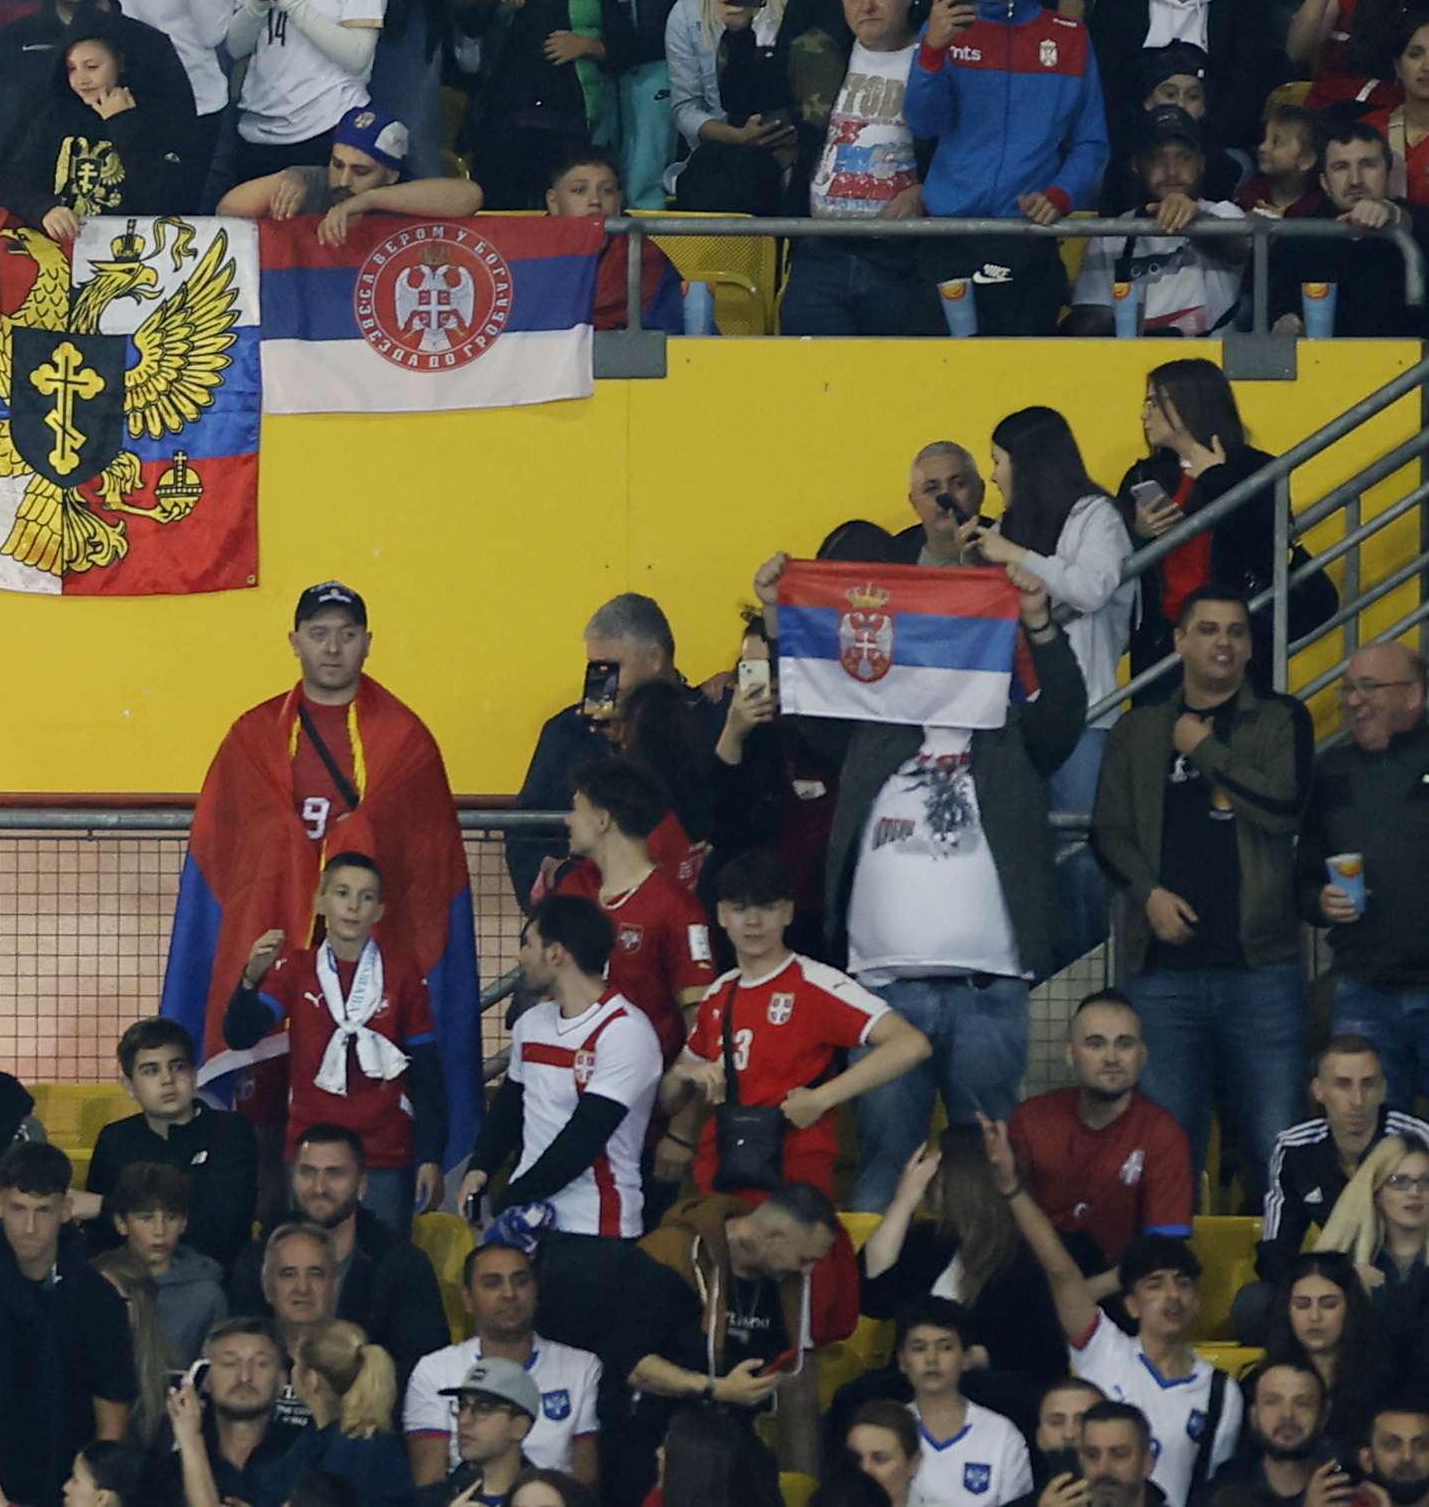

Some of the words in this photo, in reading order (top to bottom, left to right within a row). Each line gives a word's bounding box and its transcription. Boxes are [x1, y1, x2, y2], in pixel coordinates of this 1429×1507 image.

[268, 7, 288, 47] 14
[372, 226, 445, 266] ВЕРОМ
[473, 240, 510, 296] БОГА
[357, 304, 420, 368] ЗВЕЗДА
[427, 353, 457, 369] ДО
[462, 296, 510, 358] ГРОБА
[302, 797, 330, 840] 9
